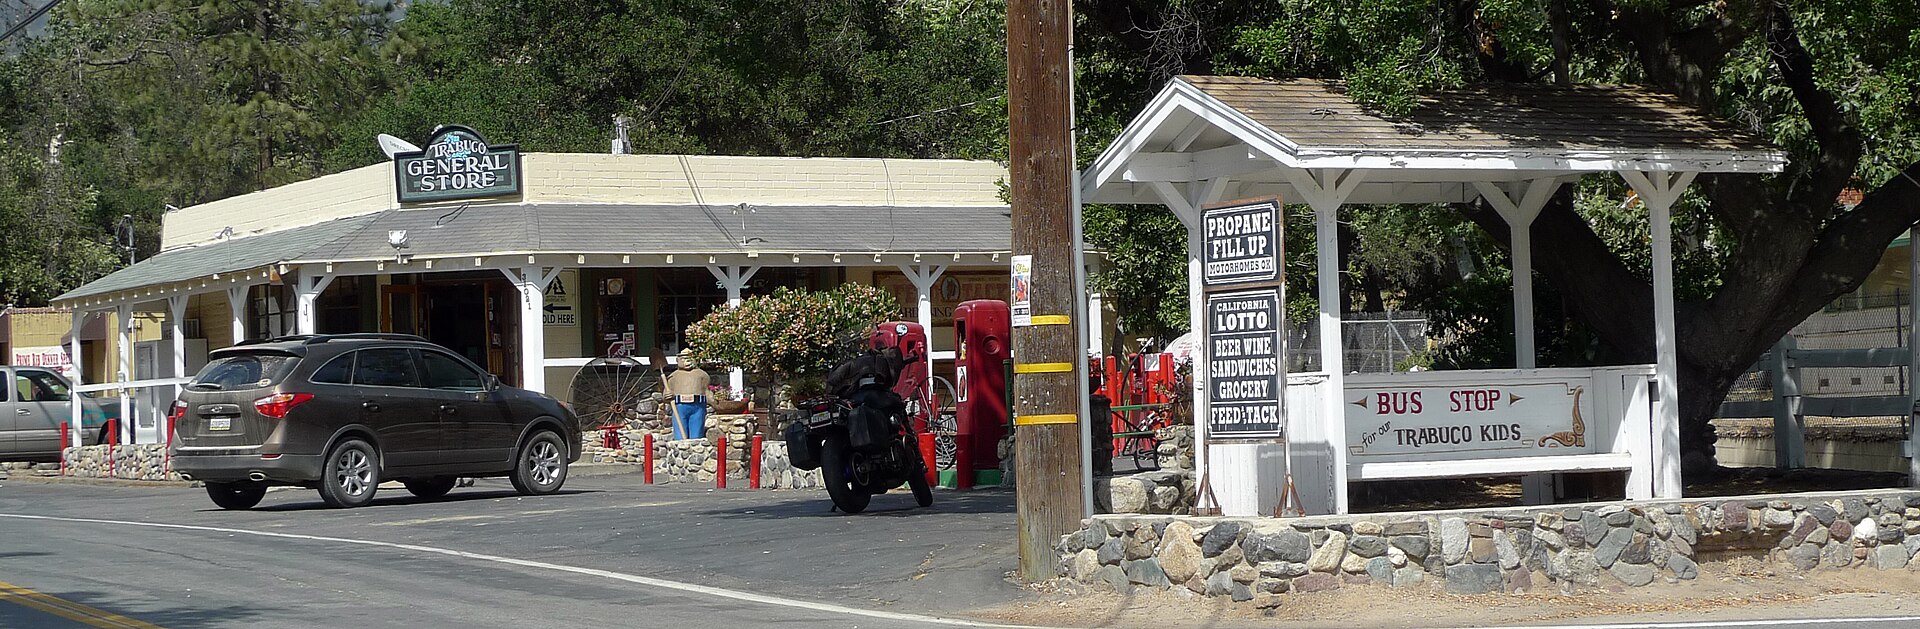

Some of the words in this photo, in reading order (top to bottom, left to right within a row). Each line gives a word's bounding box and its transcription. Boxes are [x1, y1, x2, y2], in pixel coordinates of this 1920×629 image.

[429, 140, 487, 158] TRABUCO
[407, 154, 509, 176] GENERAL
[420, 171, 497, 191] STORE
[1208, 212, 1271, 238] PROPANE
[1212, 237, 1245, 259] FILL
[1248, 235, 1267, 256] UP
[1209, 260, 1259, 275] MOTORHOMES
[1261, 259, 1271, 270] OK
[1216, 299, 1269, 312] CALIFORNIA
[558, 314, 575, 324] HERE
[1217, 311, 1268, 332] LOTTO
[1215, 338, 1242, 358] BEER
[1243, 336, 1271, 356] WINE
[1211, 357, 1277, 378] SANDWICHES
[1219, 380, 1268, 399] GROCERY
[1376, 391, 1423, 415] BUS
[1450, 389, 1501, 413] STOP
[1211, 406, 1241, 425] FEED
[1246, 405, 1278, 424] TACK
[1362, 432, 1377, 449] for
[1378, 420, 1391, 436] our
[1393, 425, 1472, 447] TRABUCO
[1480, 424, 1521, 442] KIDS
